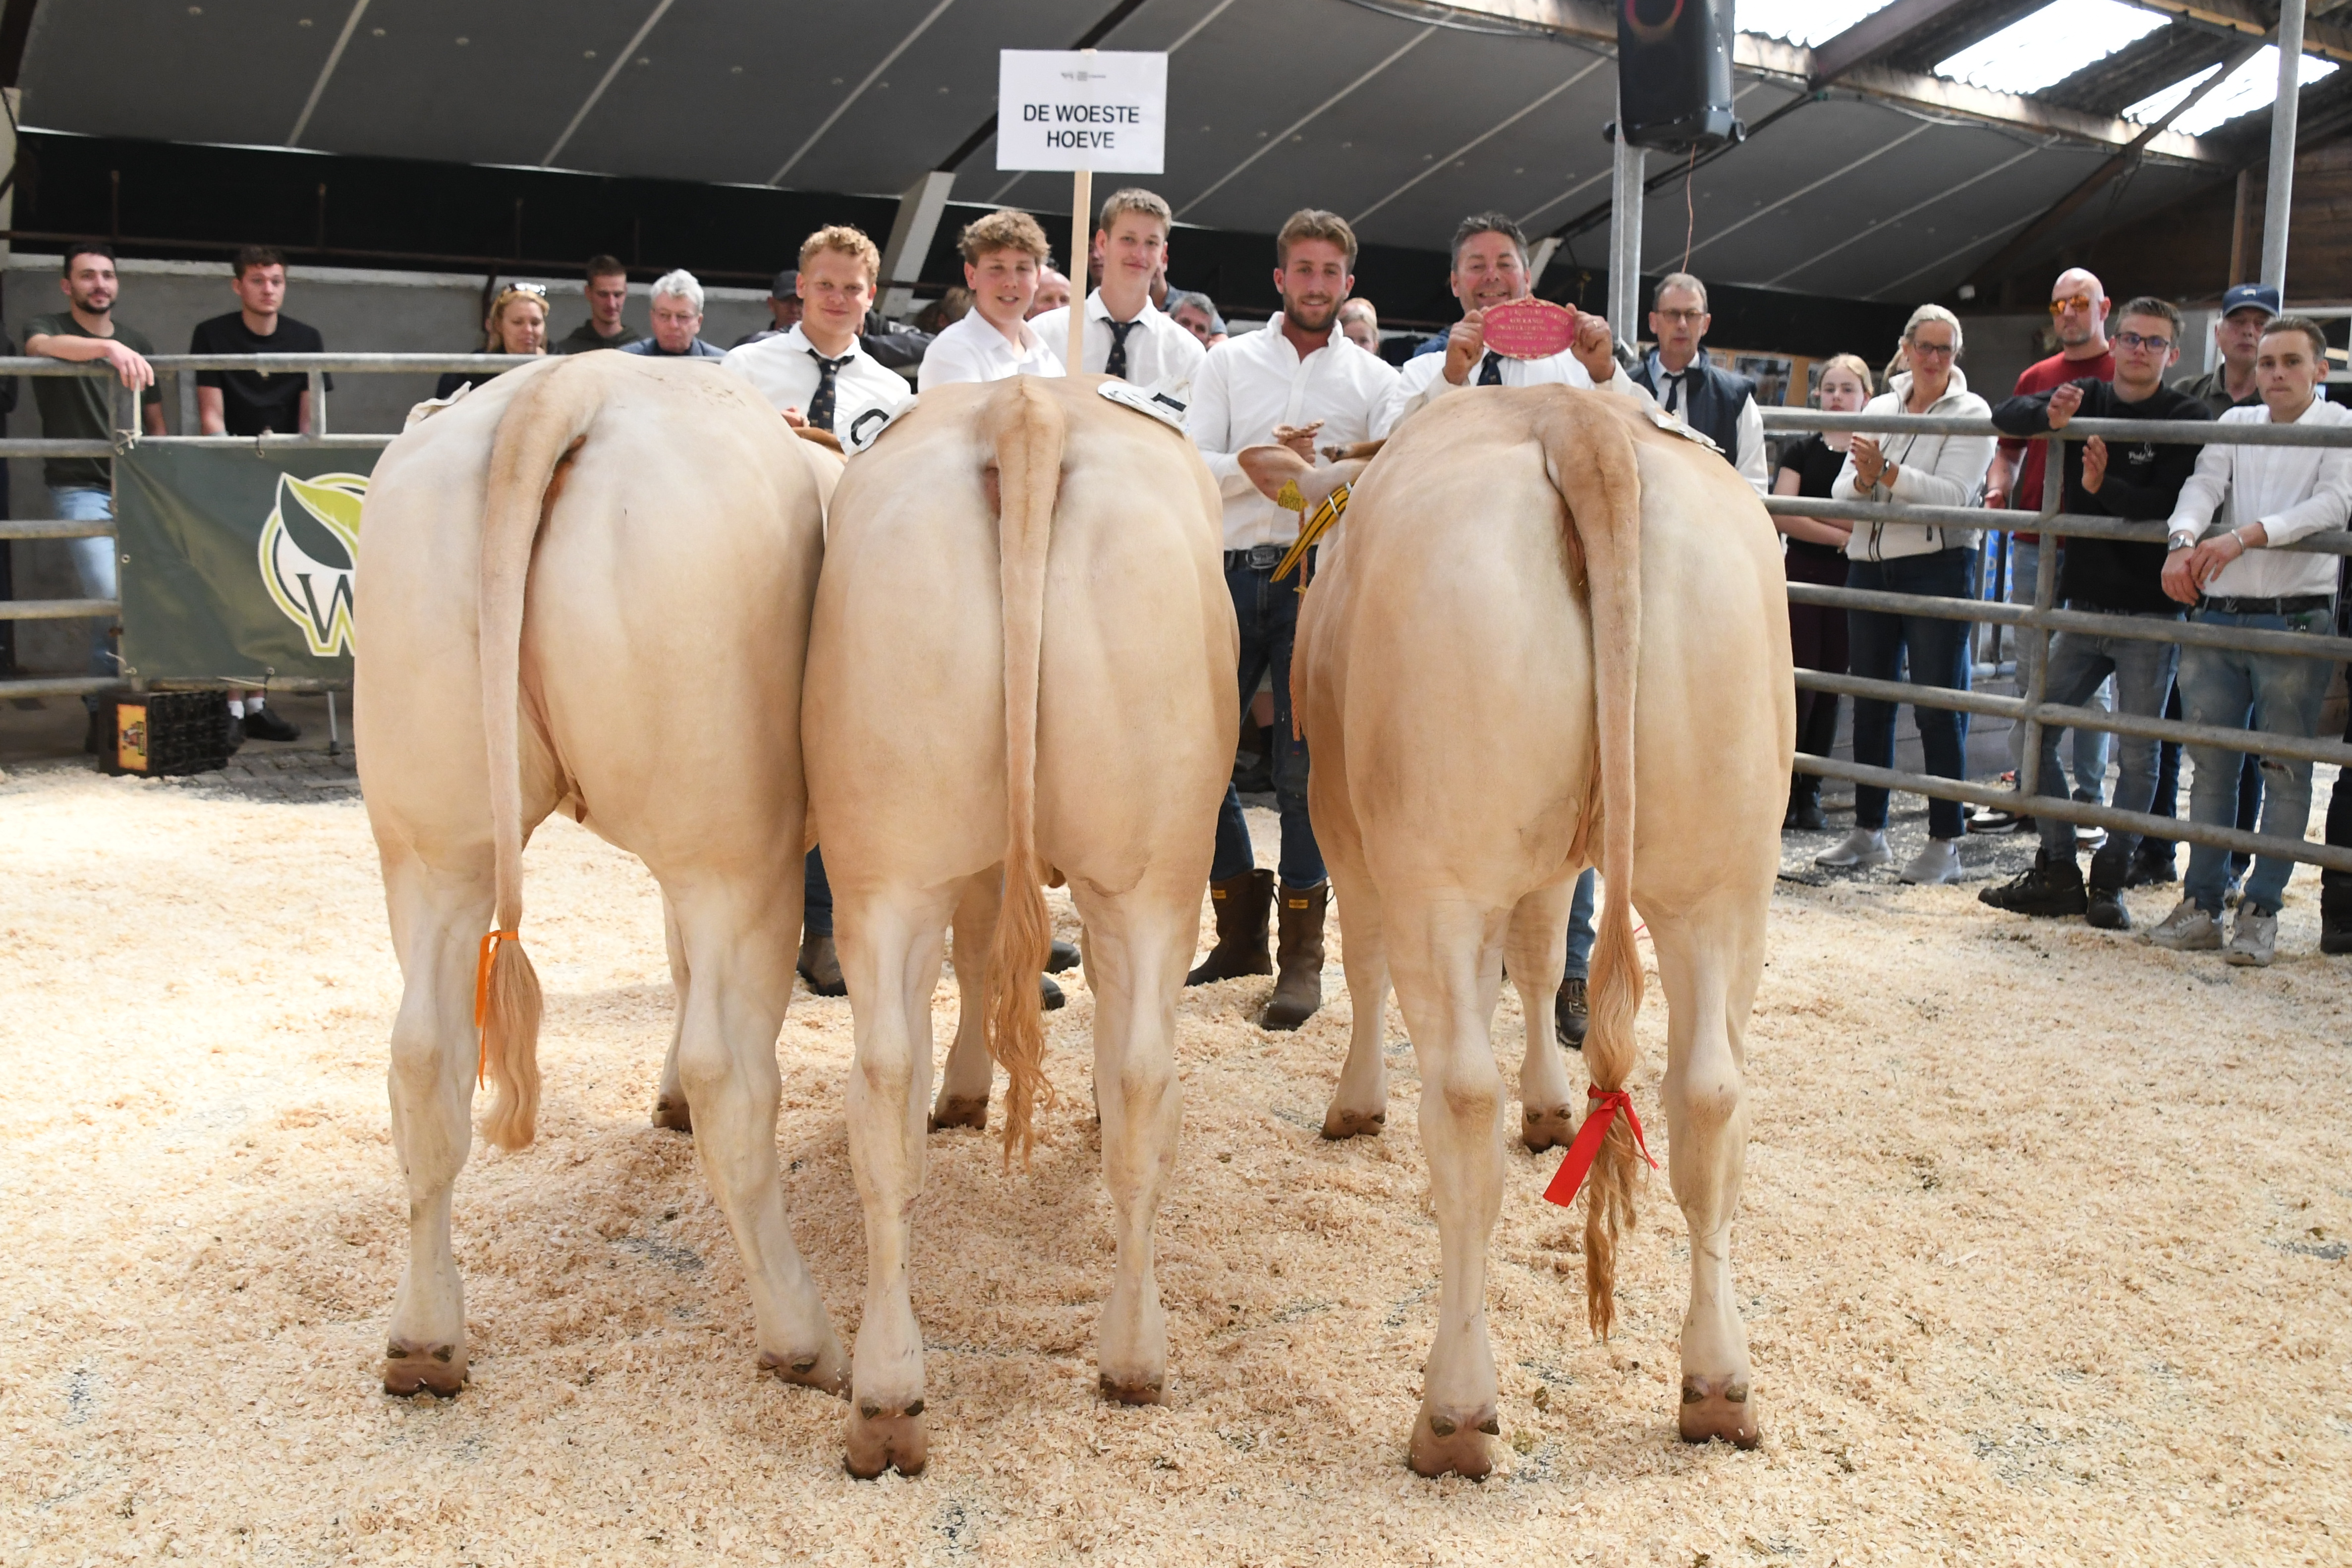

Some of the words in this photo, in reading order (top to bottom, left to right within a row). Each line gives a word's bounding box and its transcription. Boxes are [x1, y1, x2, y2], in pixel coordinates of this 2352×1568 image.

[1023, 104, 1050, 122] DE
[1056, 105, 1140, 123] WOESTE
[1047, 131, 1115, 149] HOEVE
